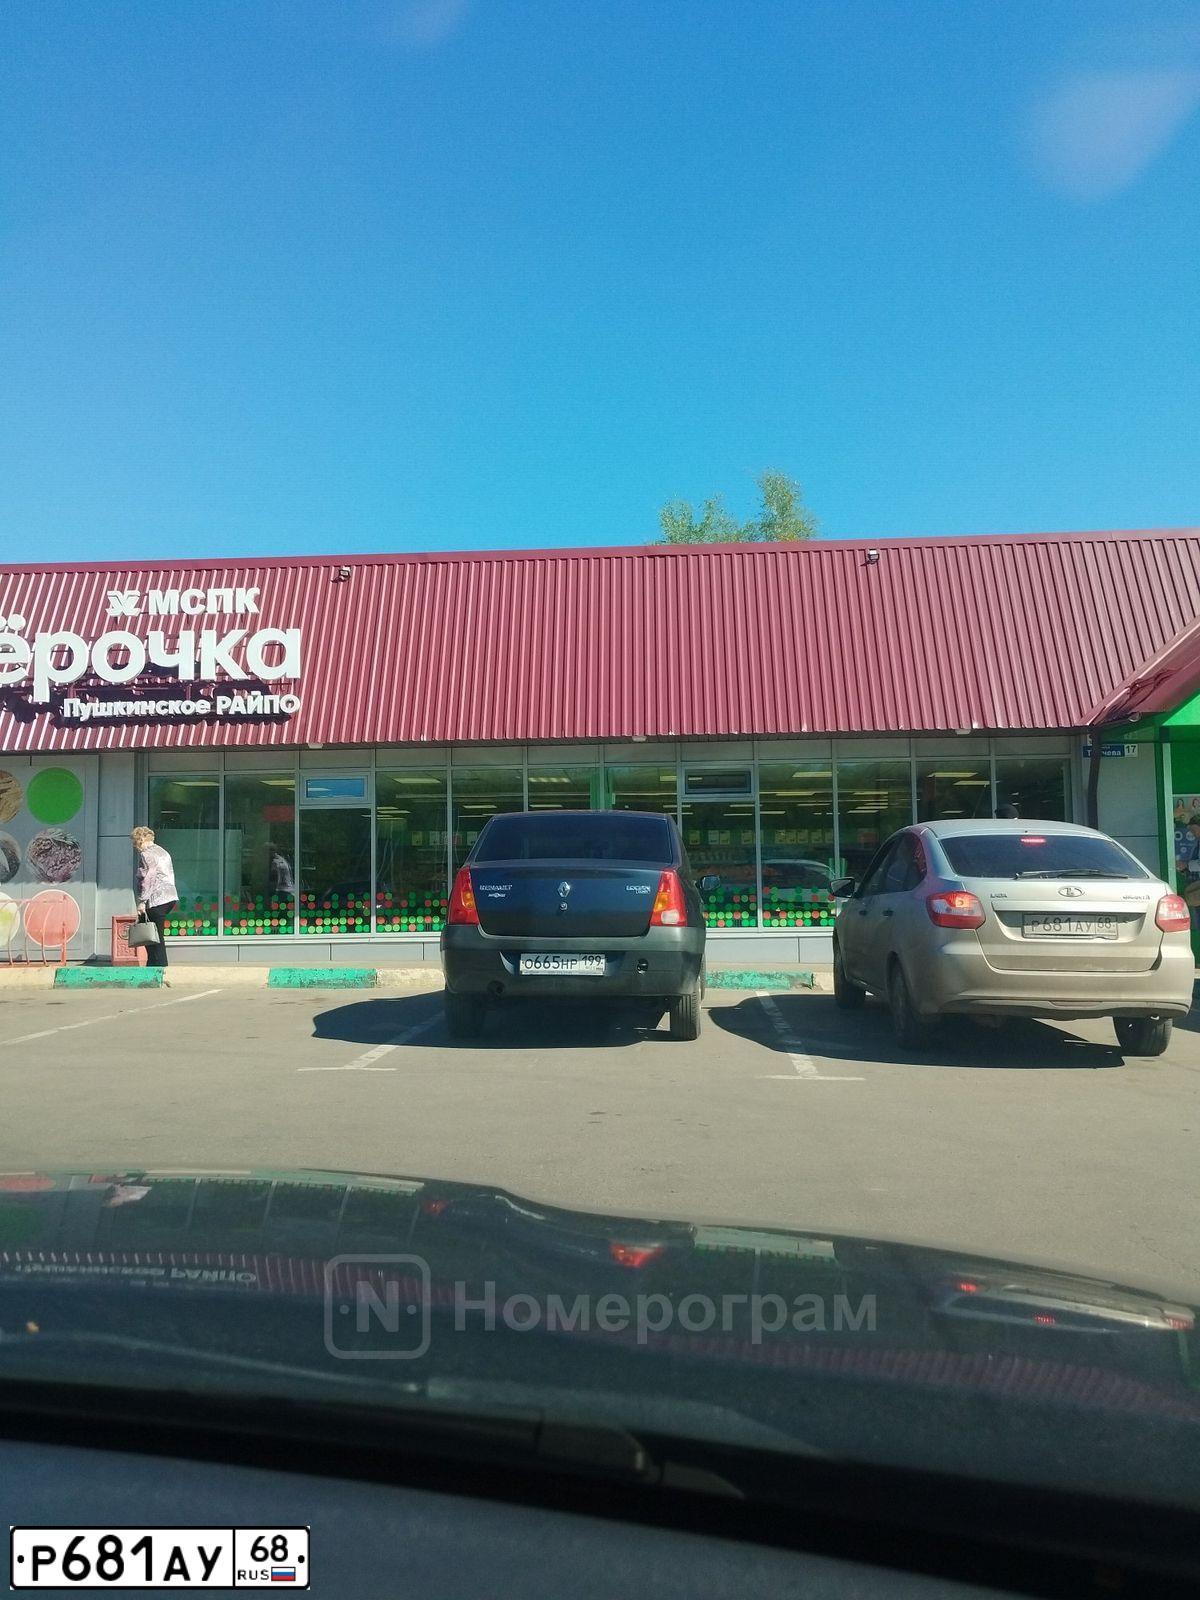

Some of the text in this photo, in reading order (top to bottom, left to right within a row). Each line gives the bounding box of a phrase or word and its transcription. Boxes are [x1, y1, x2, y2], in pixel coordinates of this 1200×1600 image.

[149, 587, 260, 616] МСПК
[63, 690, 301, 721] Пушкинское РАЙПО
[1125, 745, 1137, 754] 17
[1097, 916, 1112, 929] 68
[581, 955, 602, 967] 199
